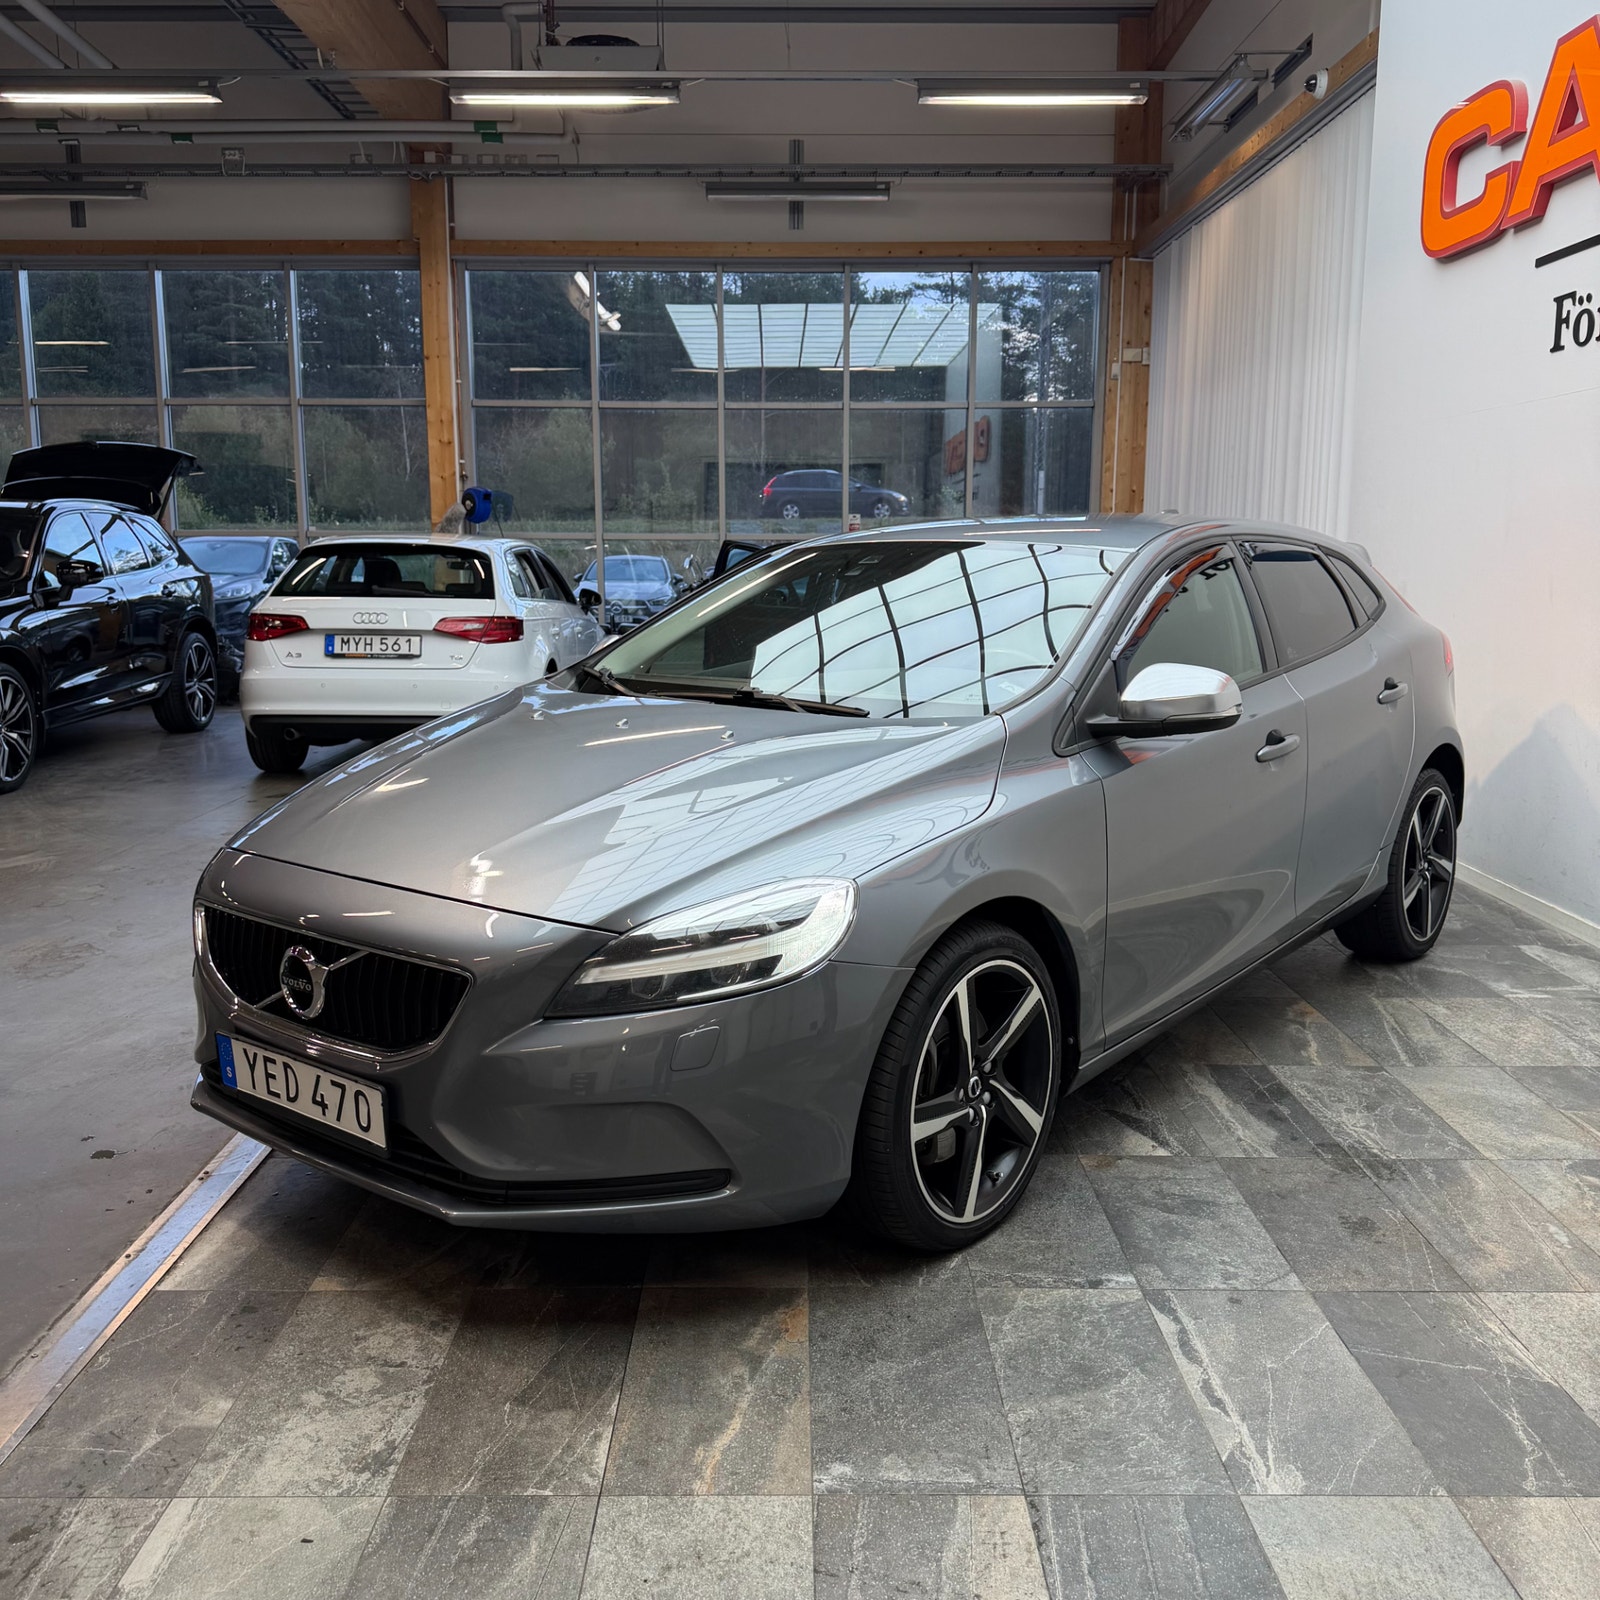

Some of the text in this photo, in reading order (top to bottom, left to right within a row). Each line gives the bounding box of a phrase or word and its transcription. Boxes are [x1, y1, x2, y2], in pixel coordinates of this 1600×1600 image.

[1549, 290, 1600, 353] Fö
[340, 636, 412, 653] MYH 561
[282, 975, 312, 992] VOLVO
[226, 1066, 233, 1078] S
[242, 1047, 372, 1134] YED 470
